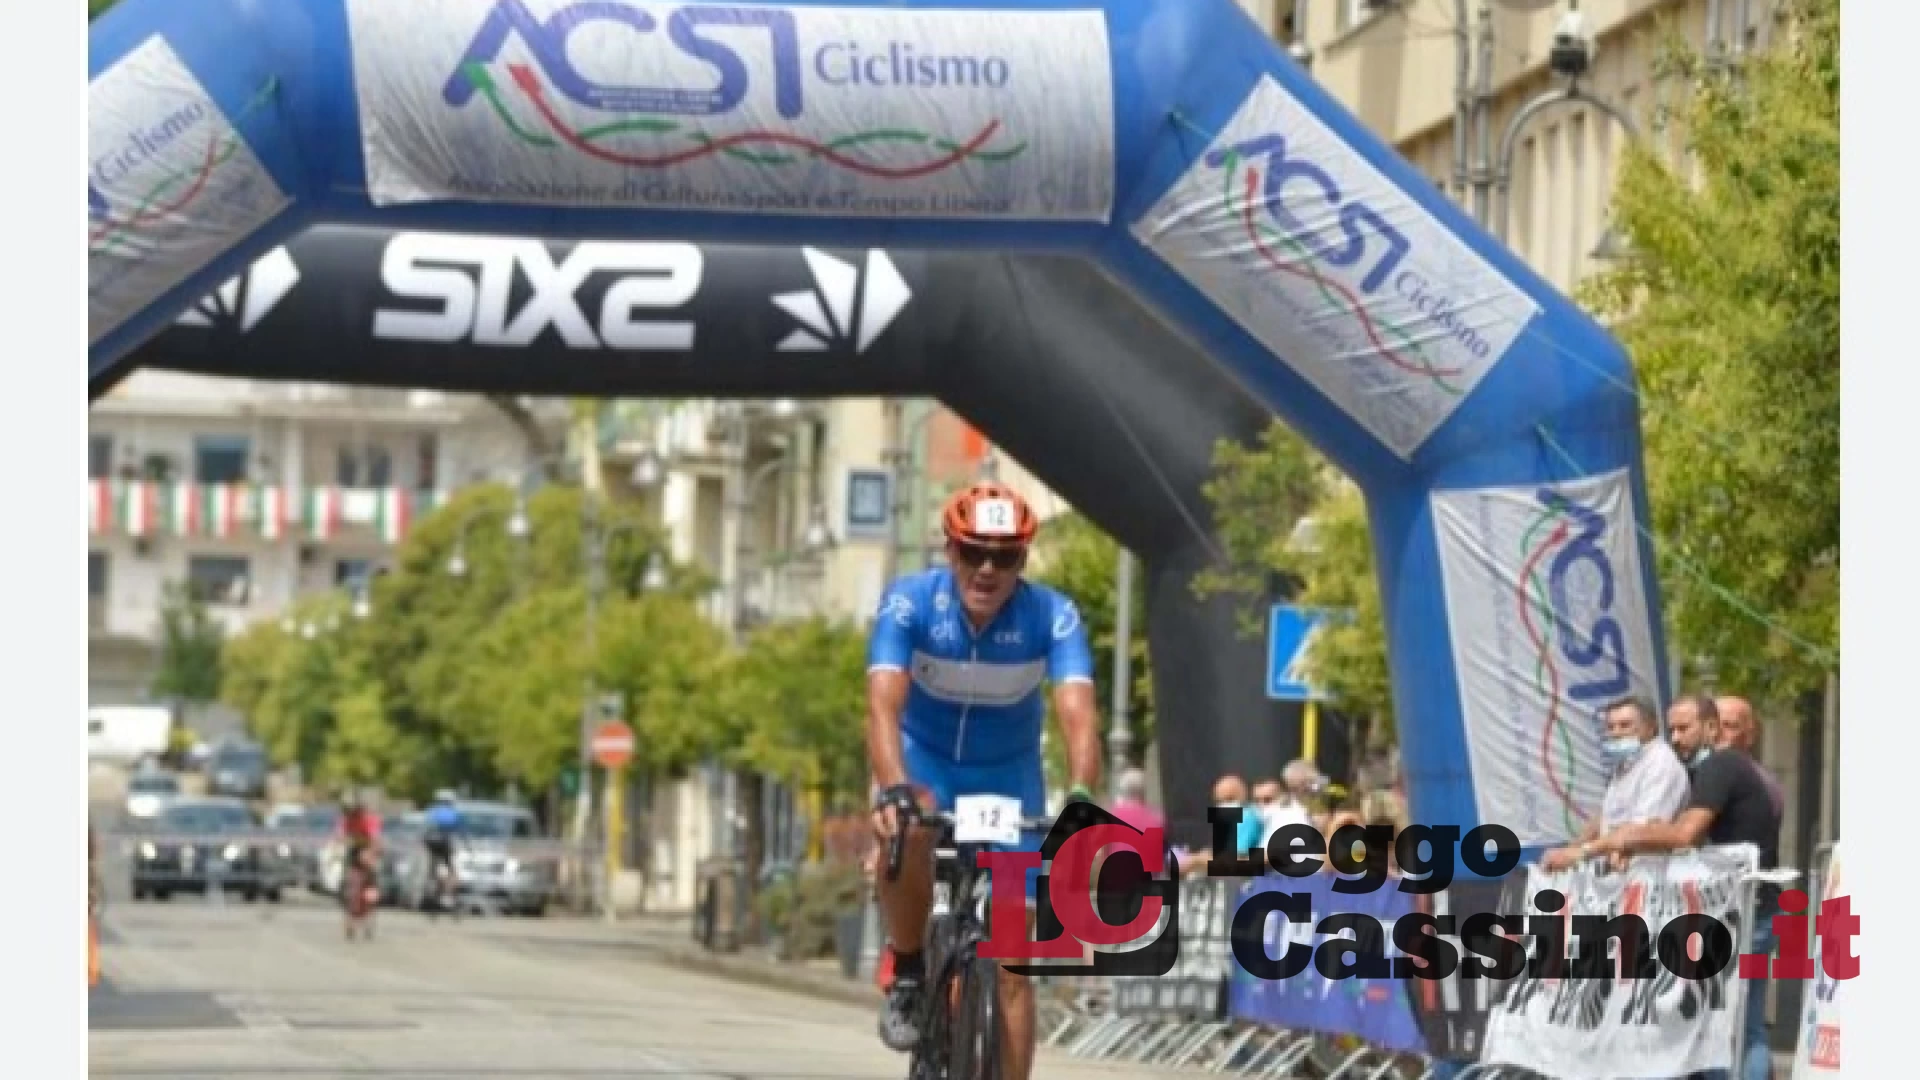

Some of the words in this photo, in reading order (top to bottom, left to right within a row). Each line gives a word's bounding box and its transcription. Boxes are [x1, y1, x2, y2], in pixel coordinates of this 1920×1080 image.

[443, 0, 803, 120] ACSI
[814, 39, 1010, 88] Ciclismo
[94, 103, 206, 185] Ciclismo
[1396, 270, 1491, 358] Ciclismo
[986, 504, 1006, 526] 12
[979, 805, 1002, 829] 12
